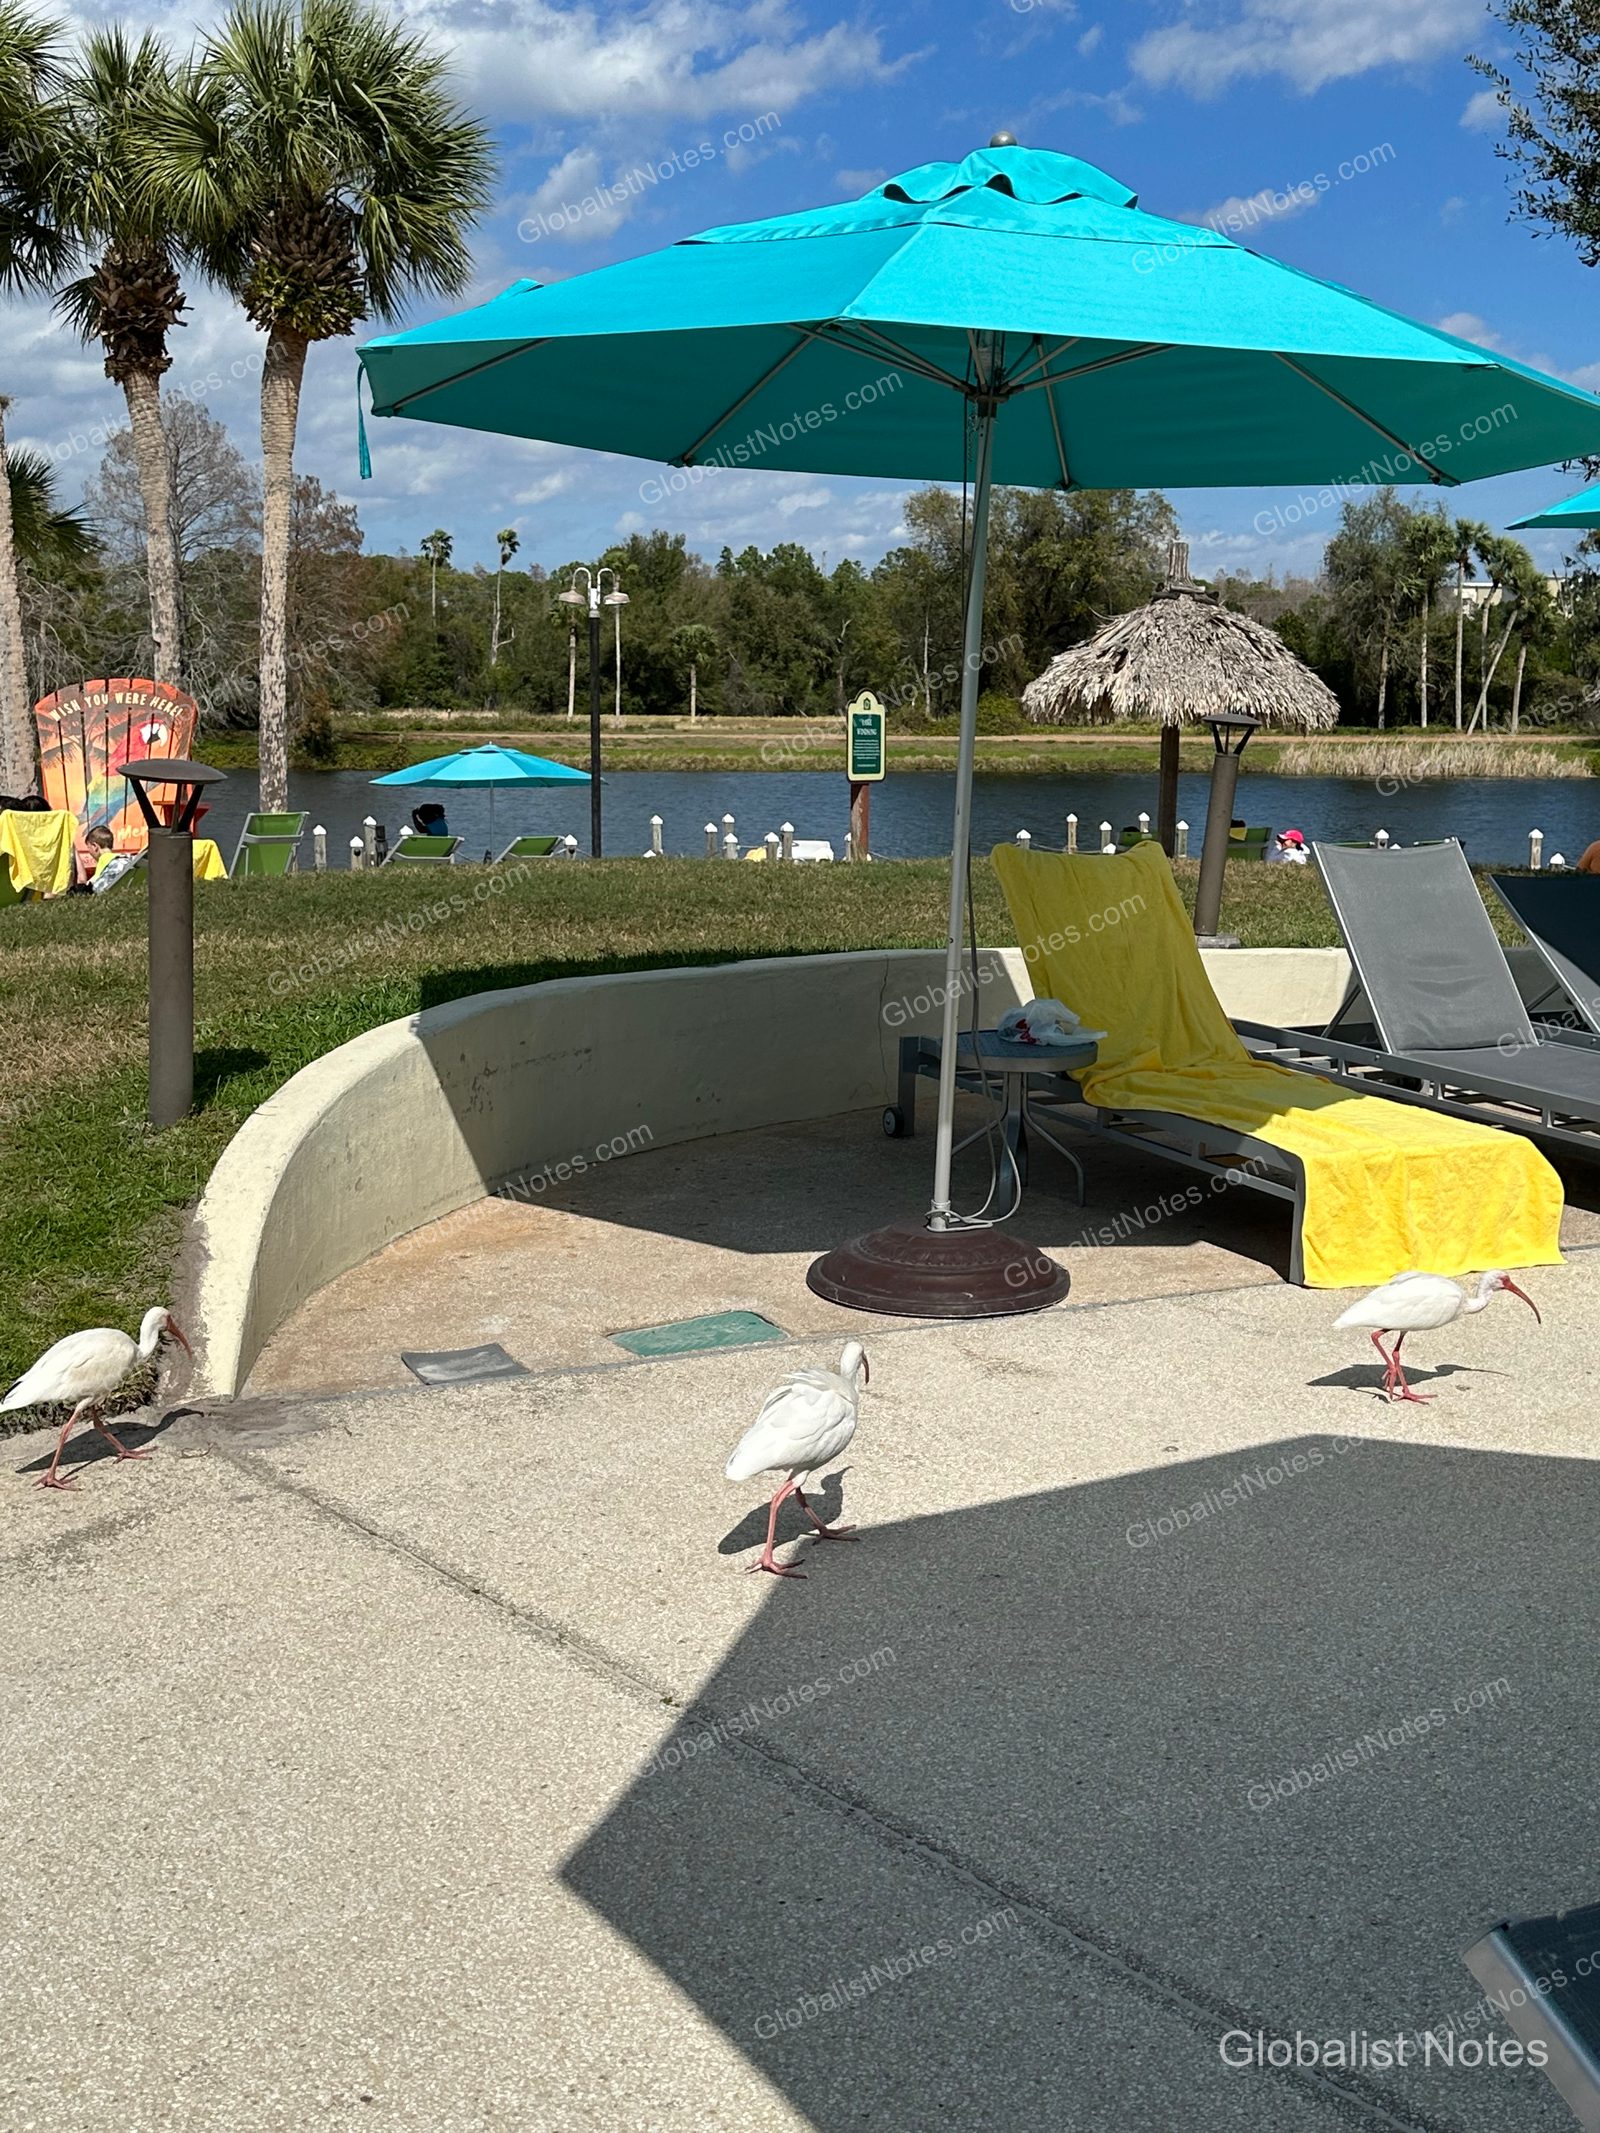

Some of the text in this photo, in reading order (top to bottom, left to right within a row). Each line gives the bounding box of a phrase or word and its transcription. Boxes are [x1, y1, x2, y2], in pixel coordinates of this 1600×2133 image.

[49, 699, 81, 721] WISH
[84, 694, 109, 708] YOU
[115, 692, 148, 706] WERE
